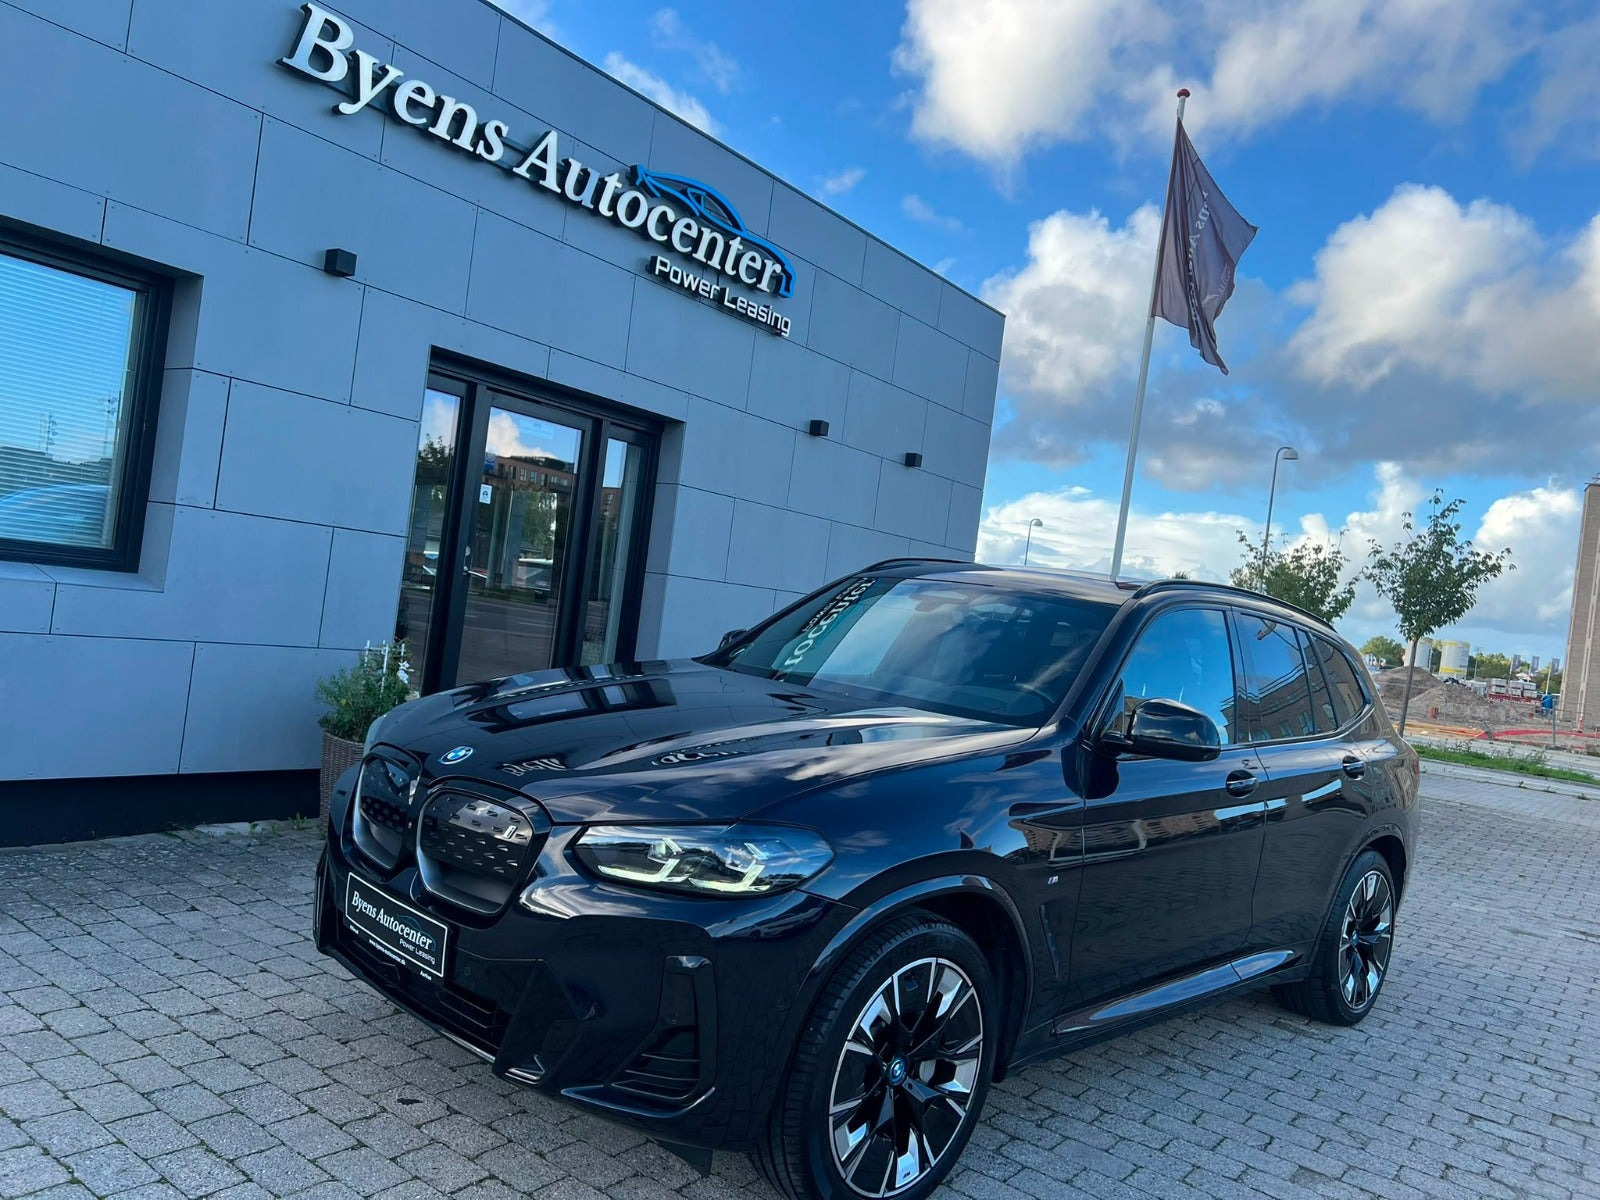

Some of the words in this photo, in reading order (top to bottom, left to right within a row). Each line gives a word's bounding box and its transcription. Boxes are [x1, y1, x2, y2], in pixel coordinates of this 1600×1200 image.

[280, 2, 509, 162] Byens
[512, 129, 783, 293] Autocenter
[654, 255, 721, 299] Power
[723, 286, 791, 338] Leasing
[351, 890, 377, 919] Byens
[376, 908, 433, 950] Autocenter
